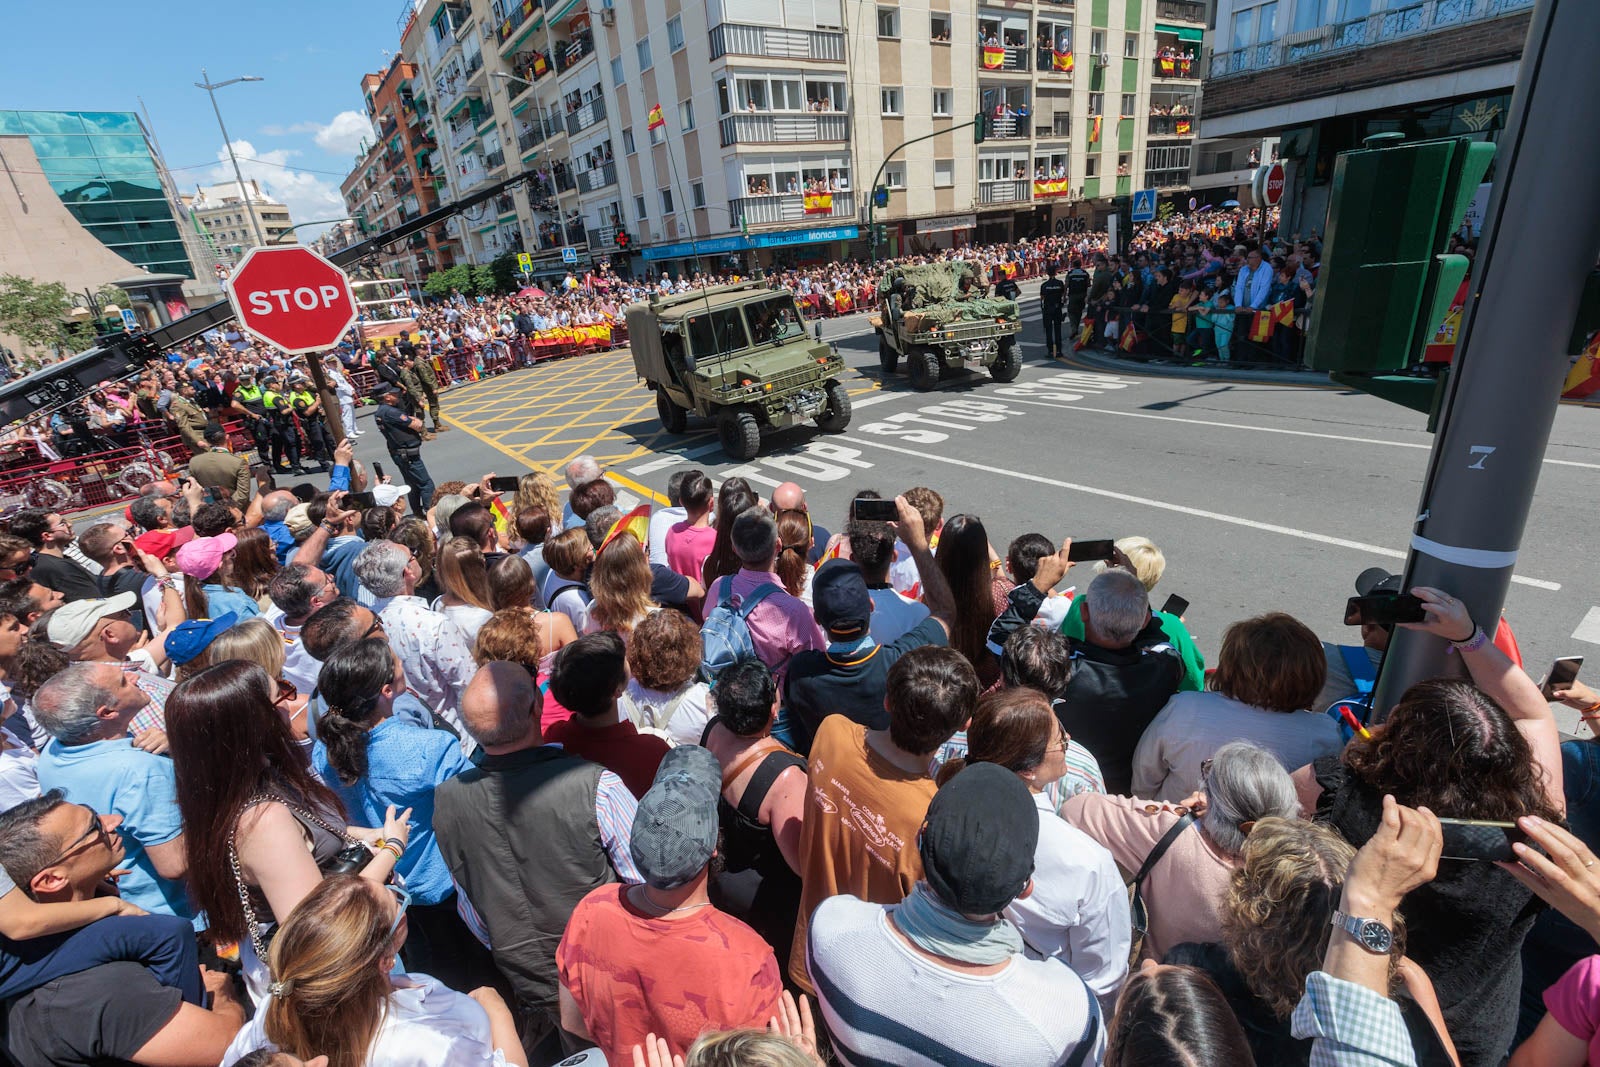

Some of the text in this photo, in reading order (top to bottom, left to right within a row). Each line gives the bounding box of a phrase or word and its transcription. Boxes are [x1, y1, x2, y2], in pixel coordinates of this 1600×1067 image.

[1268, 179, 1282, 190] STOP
[248, 285, 340, 316] STOP
[994, 372, 1143, 401] STOP
[858, 400, 1026, 444] STOP
[1468, 445, 1496, 470] 7
[887, 831, 905, 848] FROM
